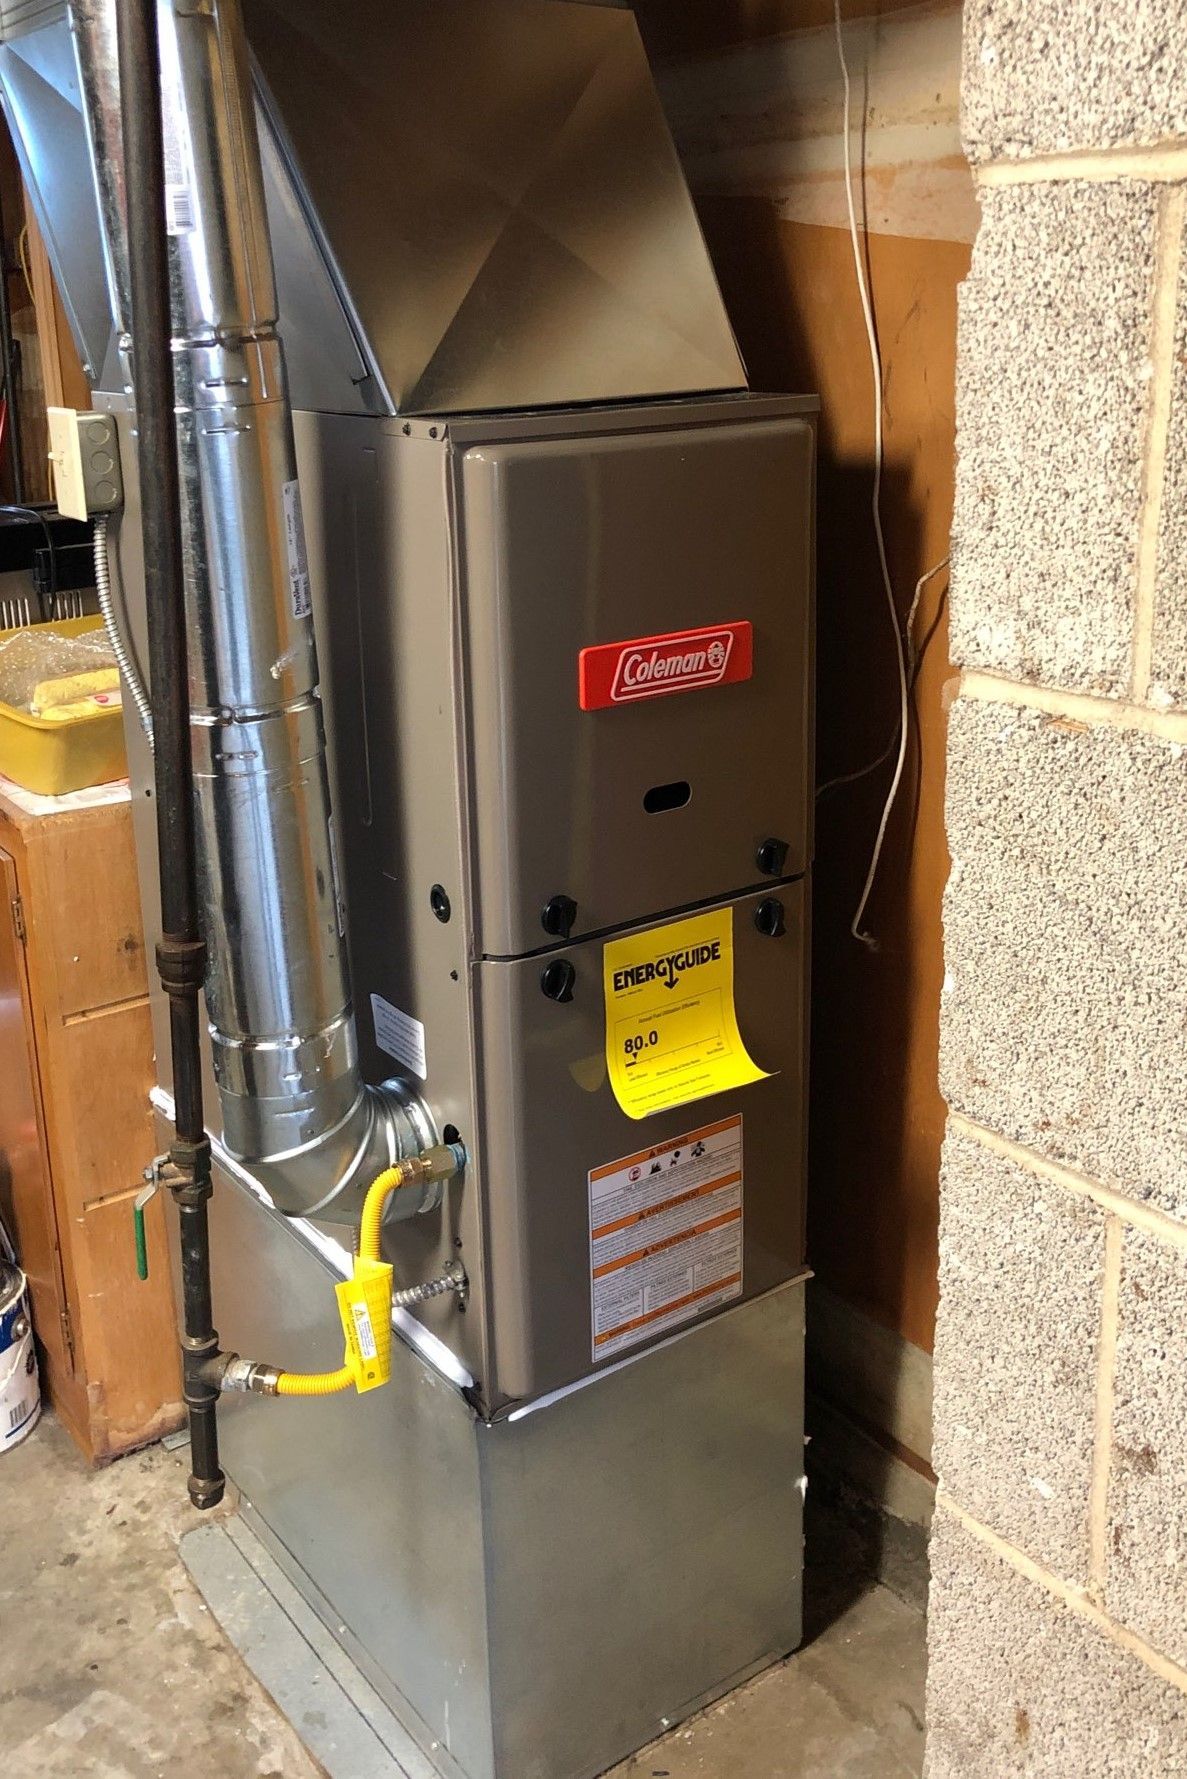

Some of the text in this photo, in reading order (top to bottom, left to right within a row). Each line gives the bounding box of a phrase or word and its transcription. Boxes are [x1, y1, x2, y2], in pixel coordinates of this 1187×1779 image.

[623, 651, 706, 686] Coleman
[613, 942, 721, 991] ENERGYGUIDE
[624, 1030, 658, 1054] 80.0
